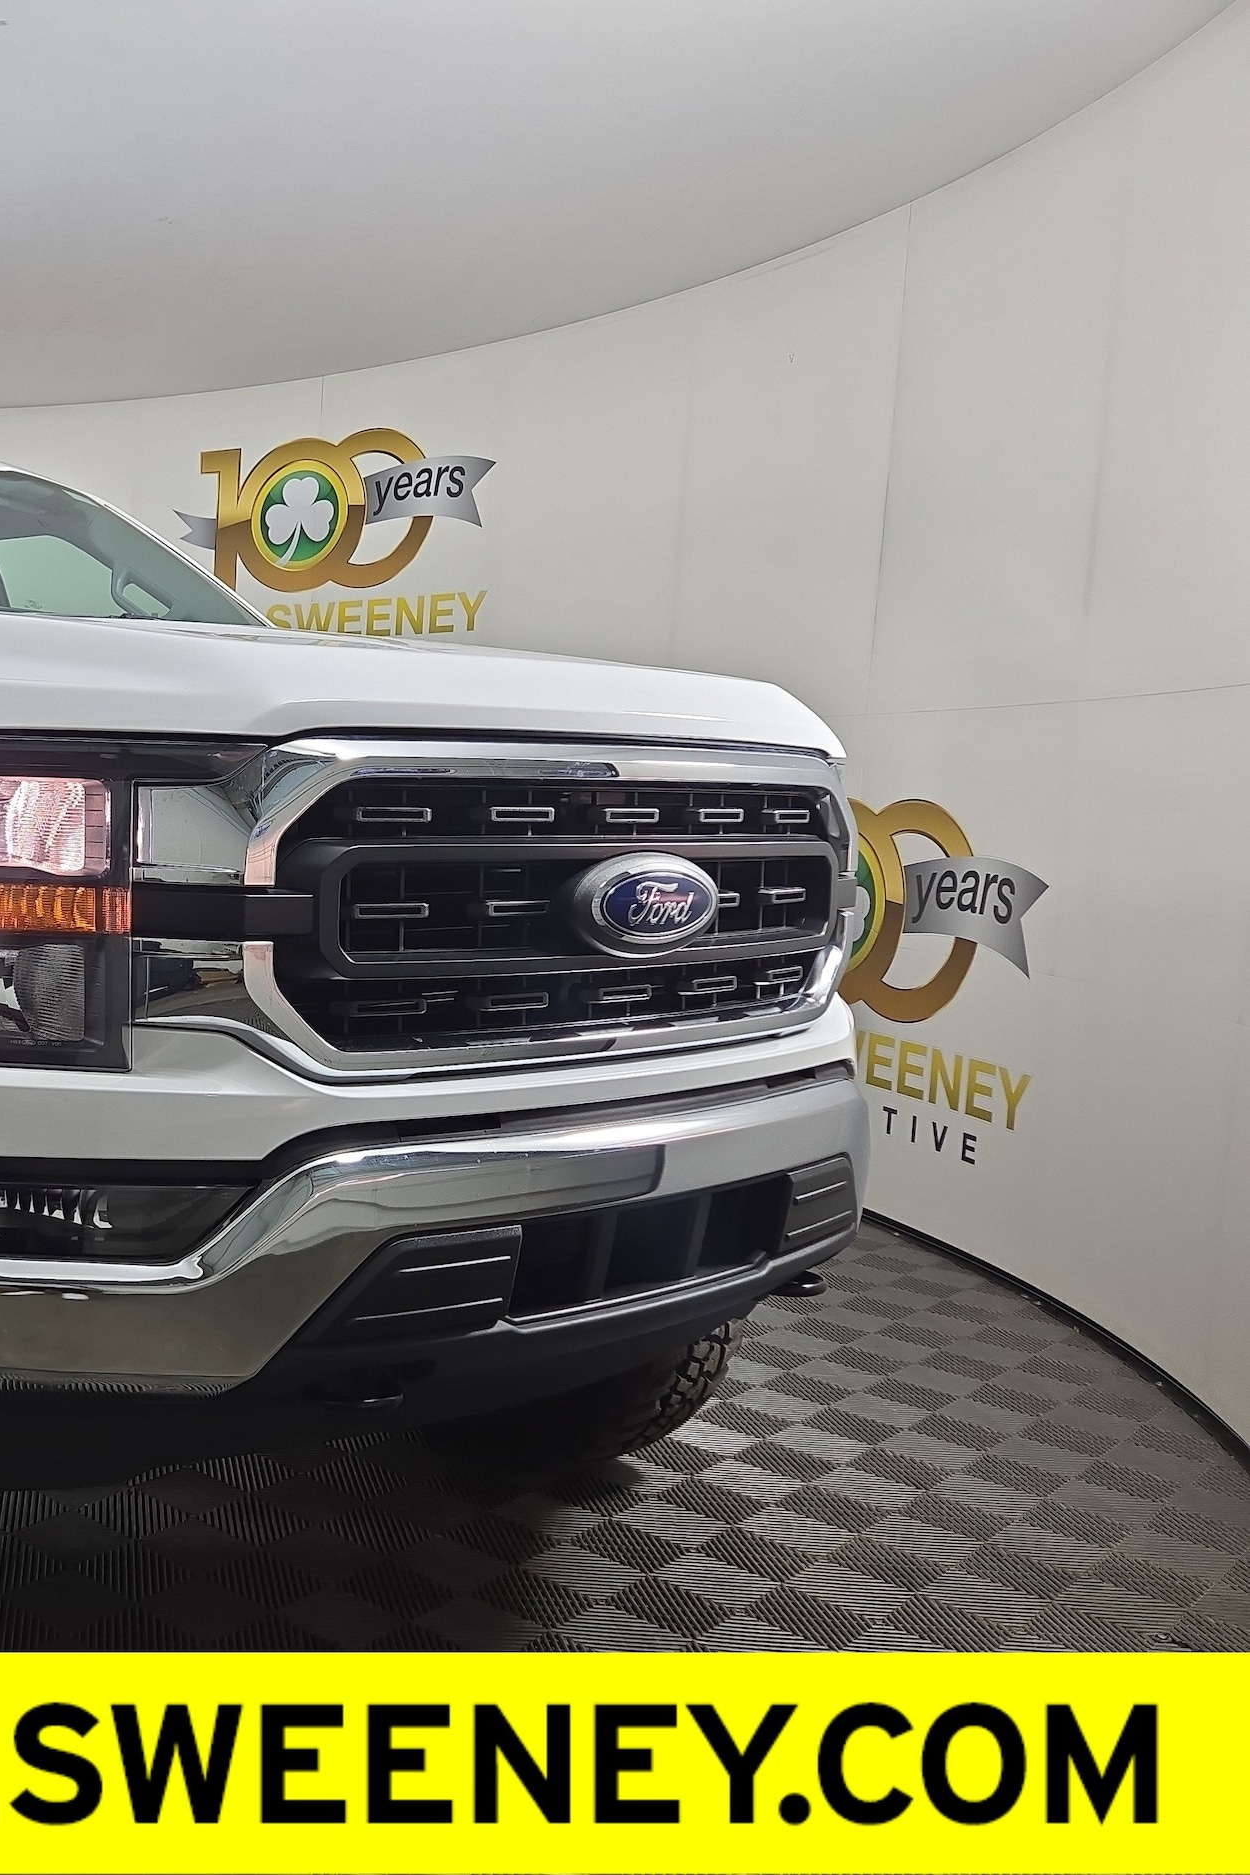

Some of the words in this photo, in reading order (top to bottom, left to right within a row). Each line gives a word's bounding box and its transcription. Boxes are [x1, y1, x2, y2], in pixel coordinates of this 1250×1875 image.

[372, 464, 466, 517] years
[266, 590, 488, 637] SWEENEY
[628, 881, 695, 926] Ford
[911, 868, 1017, 925] years
[882, 1105, 978, 1166] TIVE
